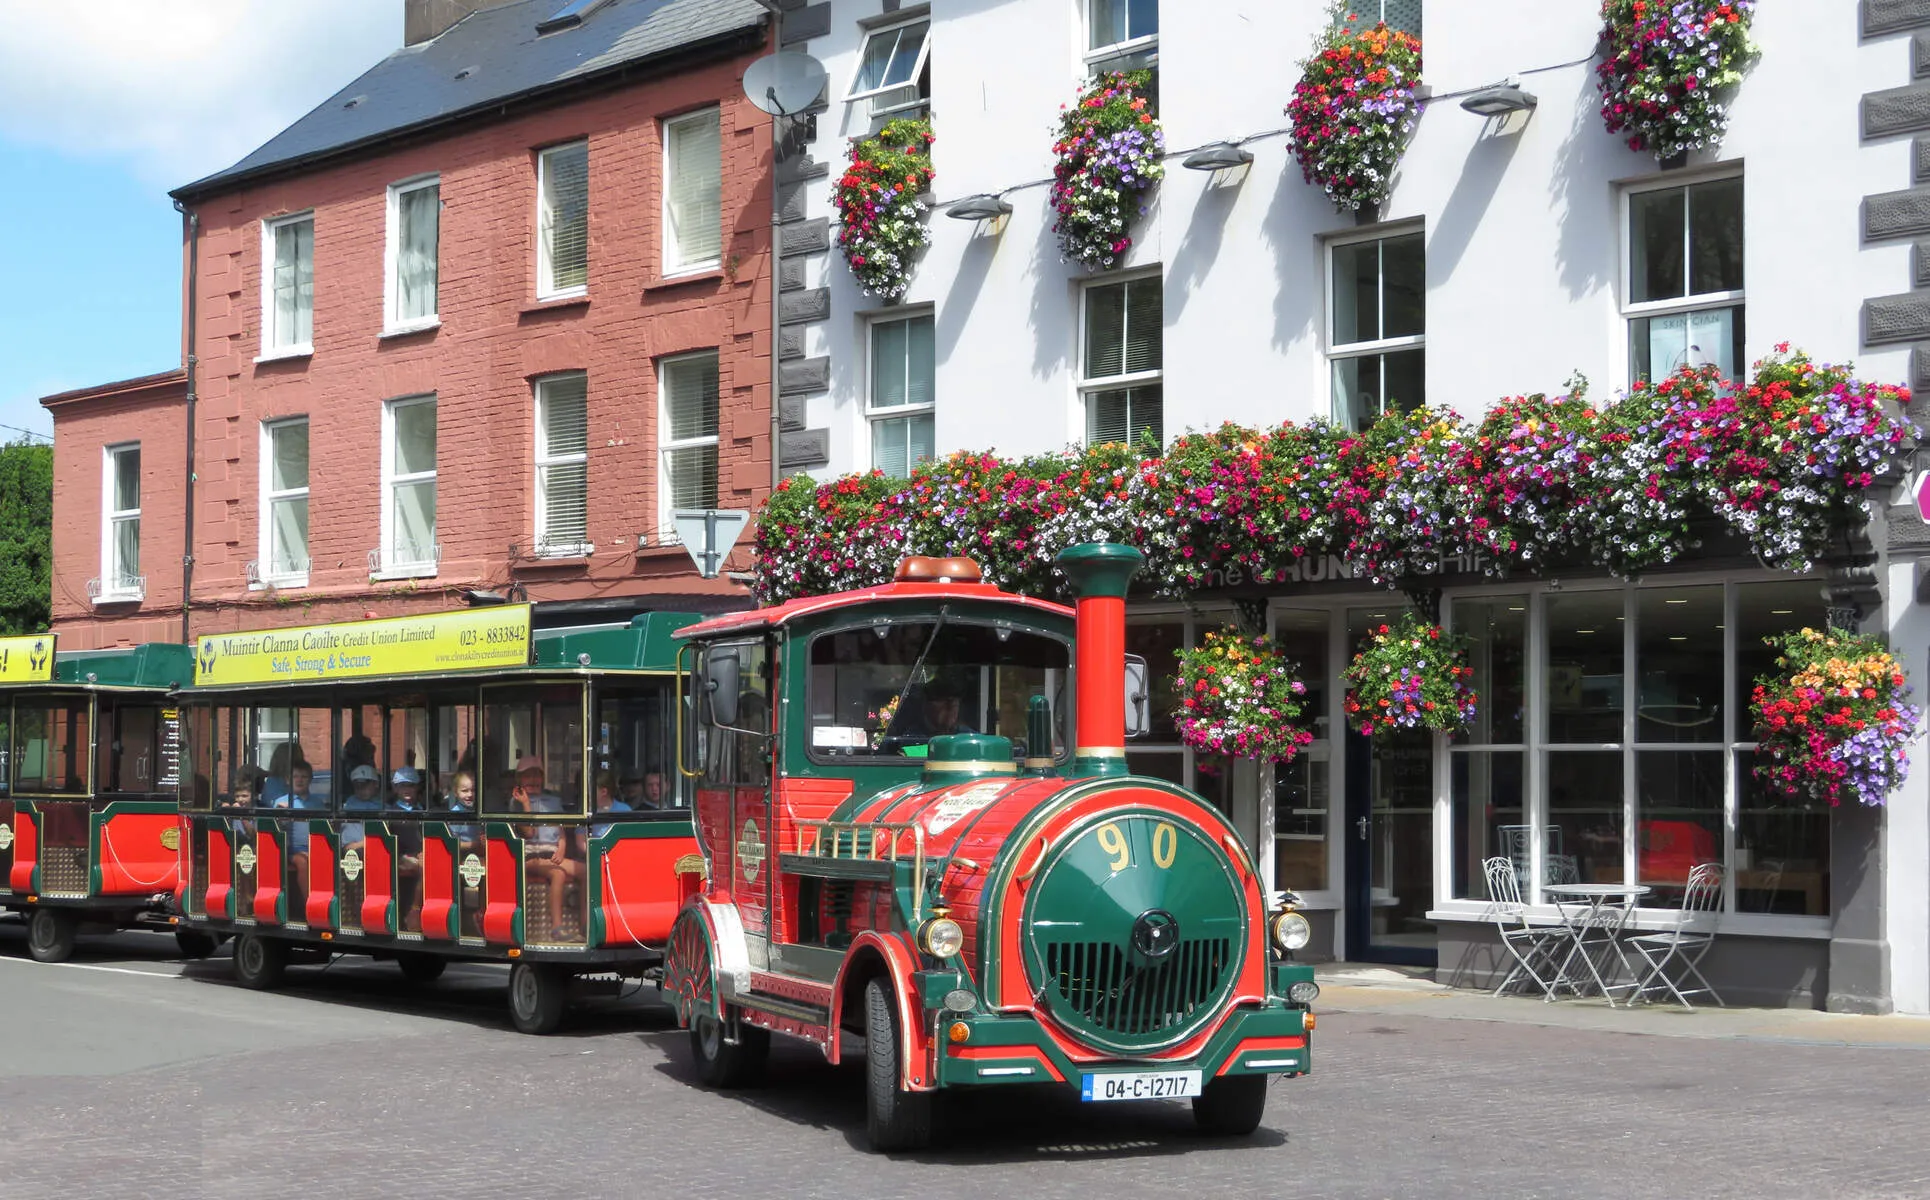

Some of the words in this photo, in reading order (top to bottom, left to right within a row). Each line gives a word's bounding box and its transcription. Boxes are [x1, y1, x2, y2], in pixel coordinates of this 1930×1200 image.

[222, 638, 261, 657] Muintir
[262, 635, 299, 654] Clanna
[302, 631, 340, 651] Caoilte
[342, 632, 369, 648] Credit
[371, 630, 398, 645] Union
[400, 625, 436, 642] Limited
[459, 630, 477, 647] 023
[486, 624, 526, 644] 8833842
[271, 656, 293, 675] Safe,
[295, 655, 325, 675] Strong
[327, 653, 336, 669] &
[338, 652, 372, 669] Secure
[1106, 1077, 1188, 1098] 04-C-12717
